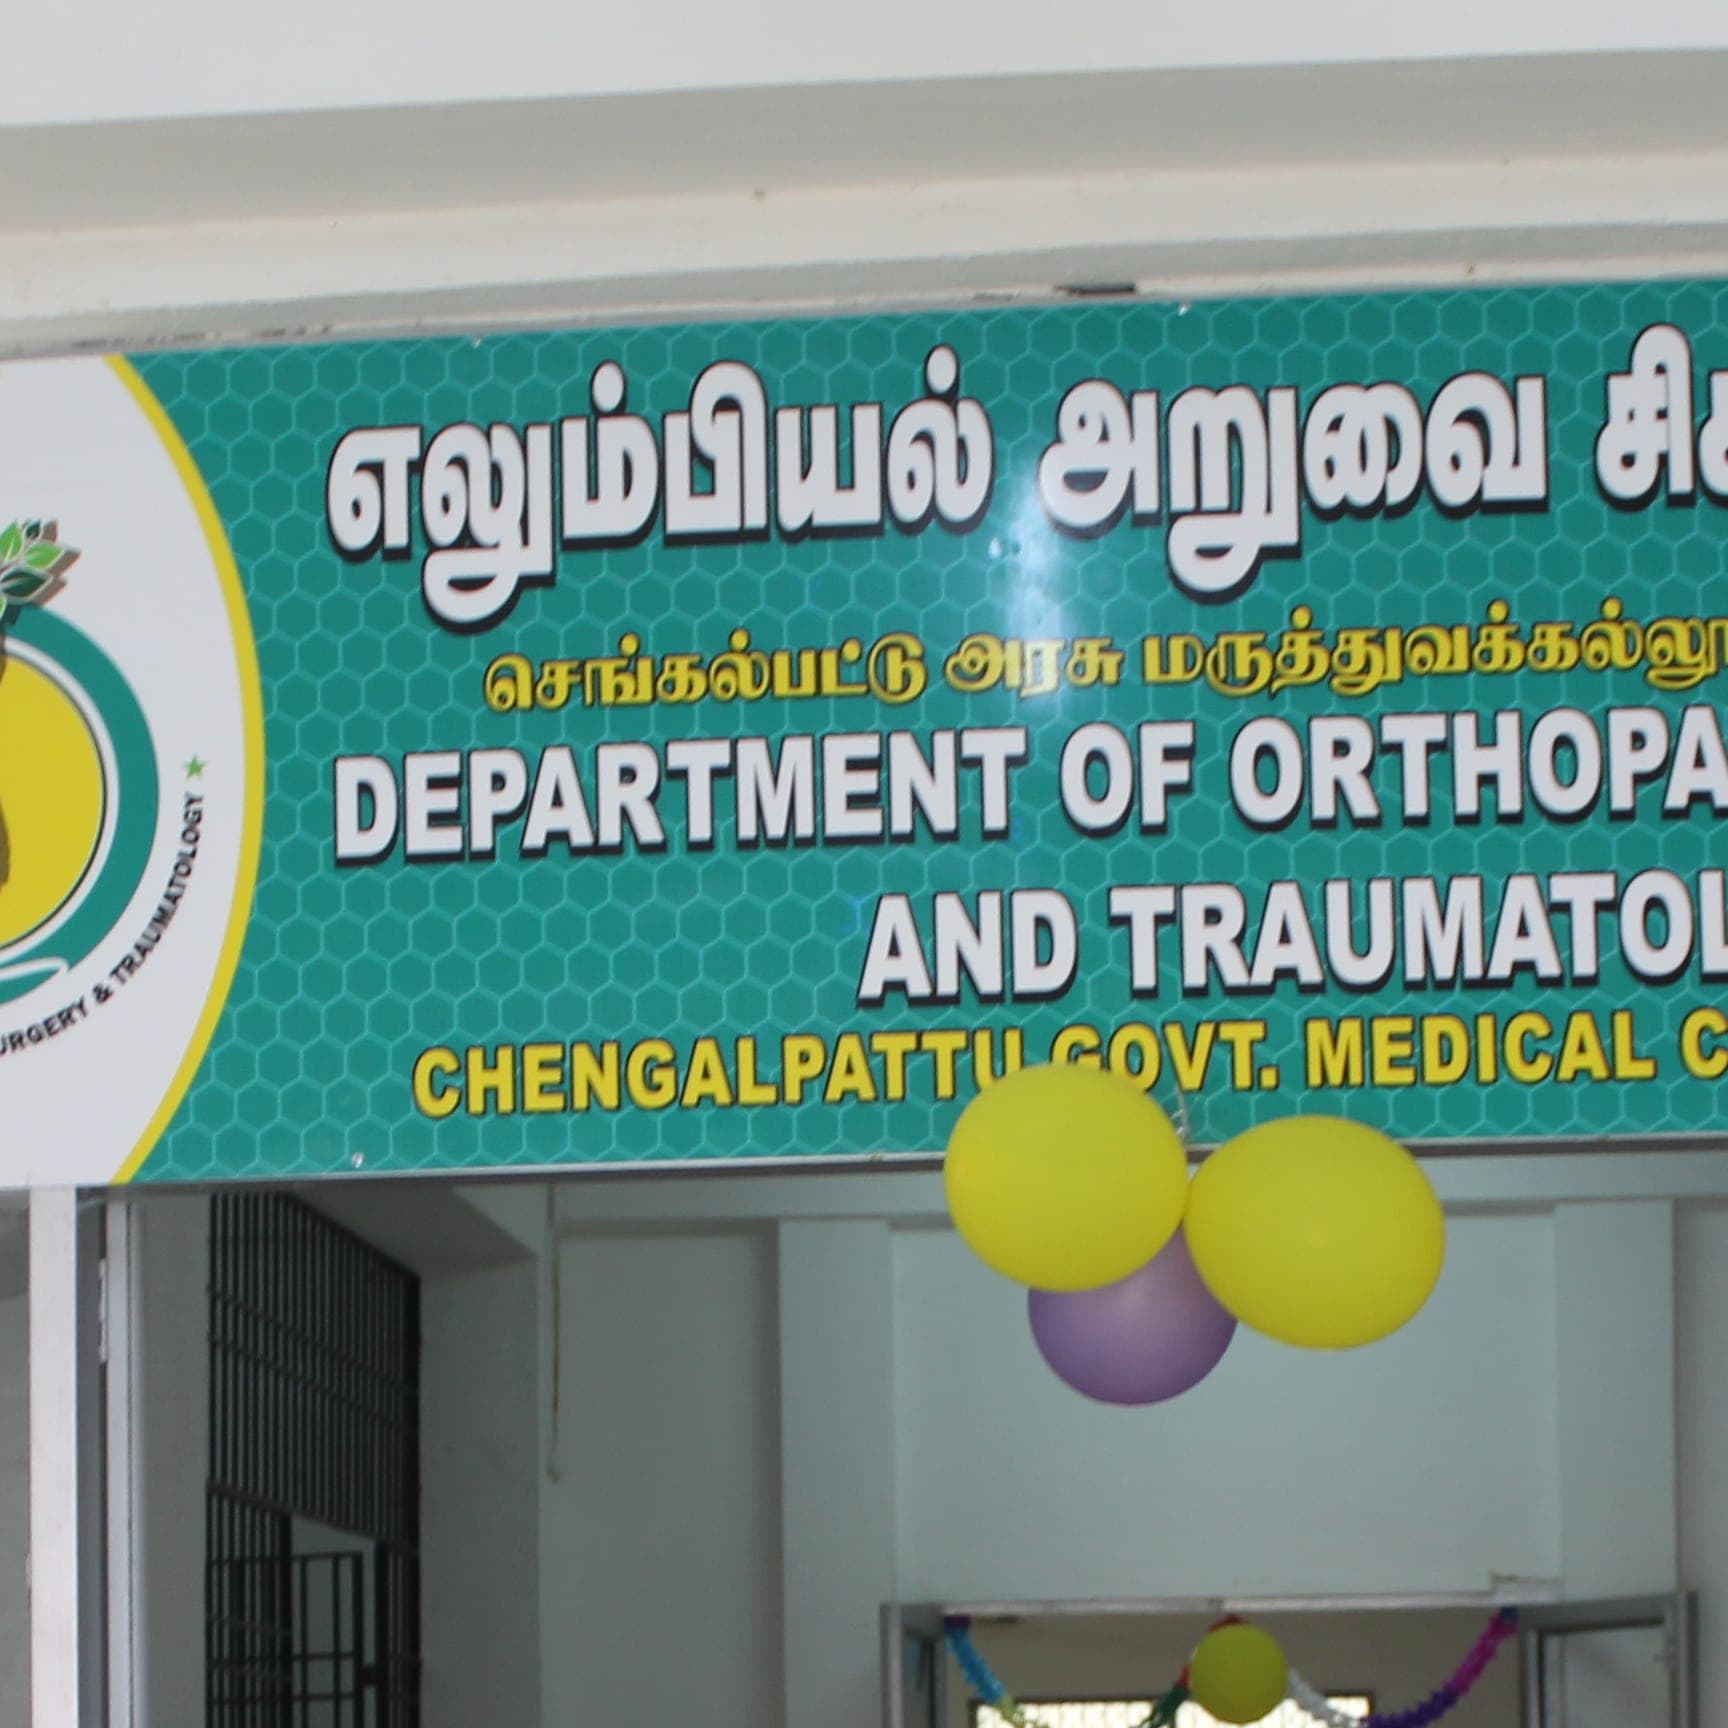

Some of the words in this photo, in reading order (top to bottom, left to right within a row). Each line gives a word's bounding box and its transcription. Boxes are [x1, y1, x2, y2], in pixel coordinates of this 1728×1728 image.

[328, 344, 994, 630] எலும்பியல்
[1038, 372, 1549, 602] அறுவை
[484, 629, 927, 711] செங்கல்பட்டு
[944, 631, 1123, 697] அரசு
[333, 727, 1028, 867] DEPARTMENT
[1059, 719, 1195, 837] OF
[91, 980, 114, 1006] &
[108, 792, 204, 988] TRAUMATOLOGY
[858, 887, 1076, 1009] AND
[411, 1026, 1021, 1118] CHENGALPATTU
[1303, 1008, 1654, 1089] MEDICAL
